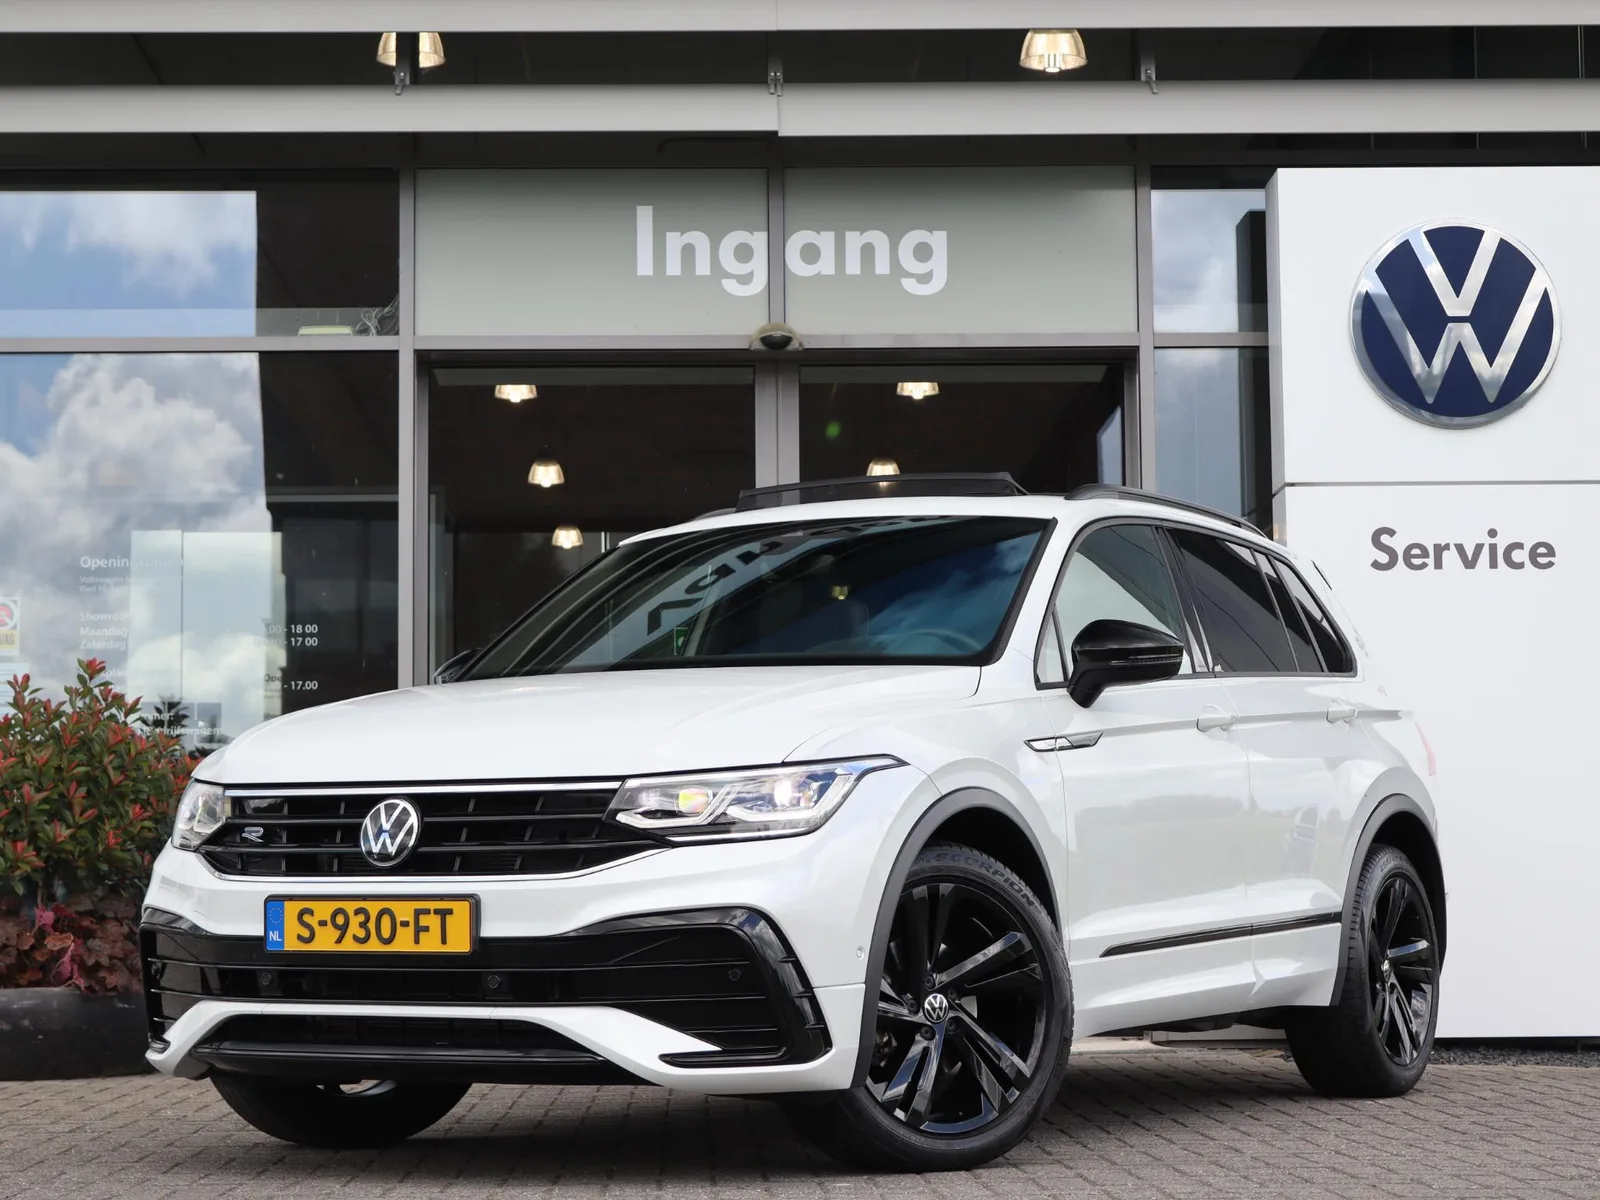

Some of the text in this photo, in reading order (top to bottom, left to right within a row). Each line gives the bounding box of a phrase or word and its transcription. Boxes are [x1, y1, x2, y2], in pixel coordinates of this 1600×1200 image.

[636, 205, 948, 297] Ingang
[1370, 526, 1556, 572] Service
[290, 680, 319, 690] 17.00
[269, 931, 283, 942] NL
[296, 907, 454, 946] S-930-FT
